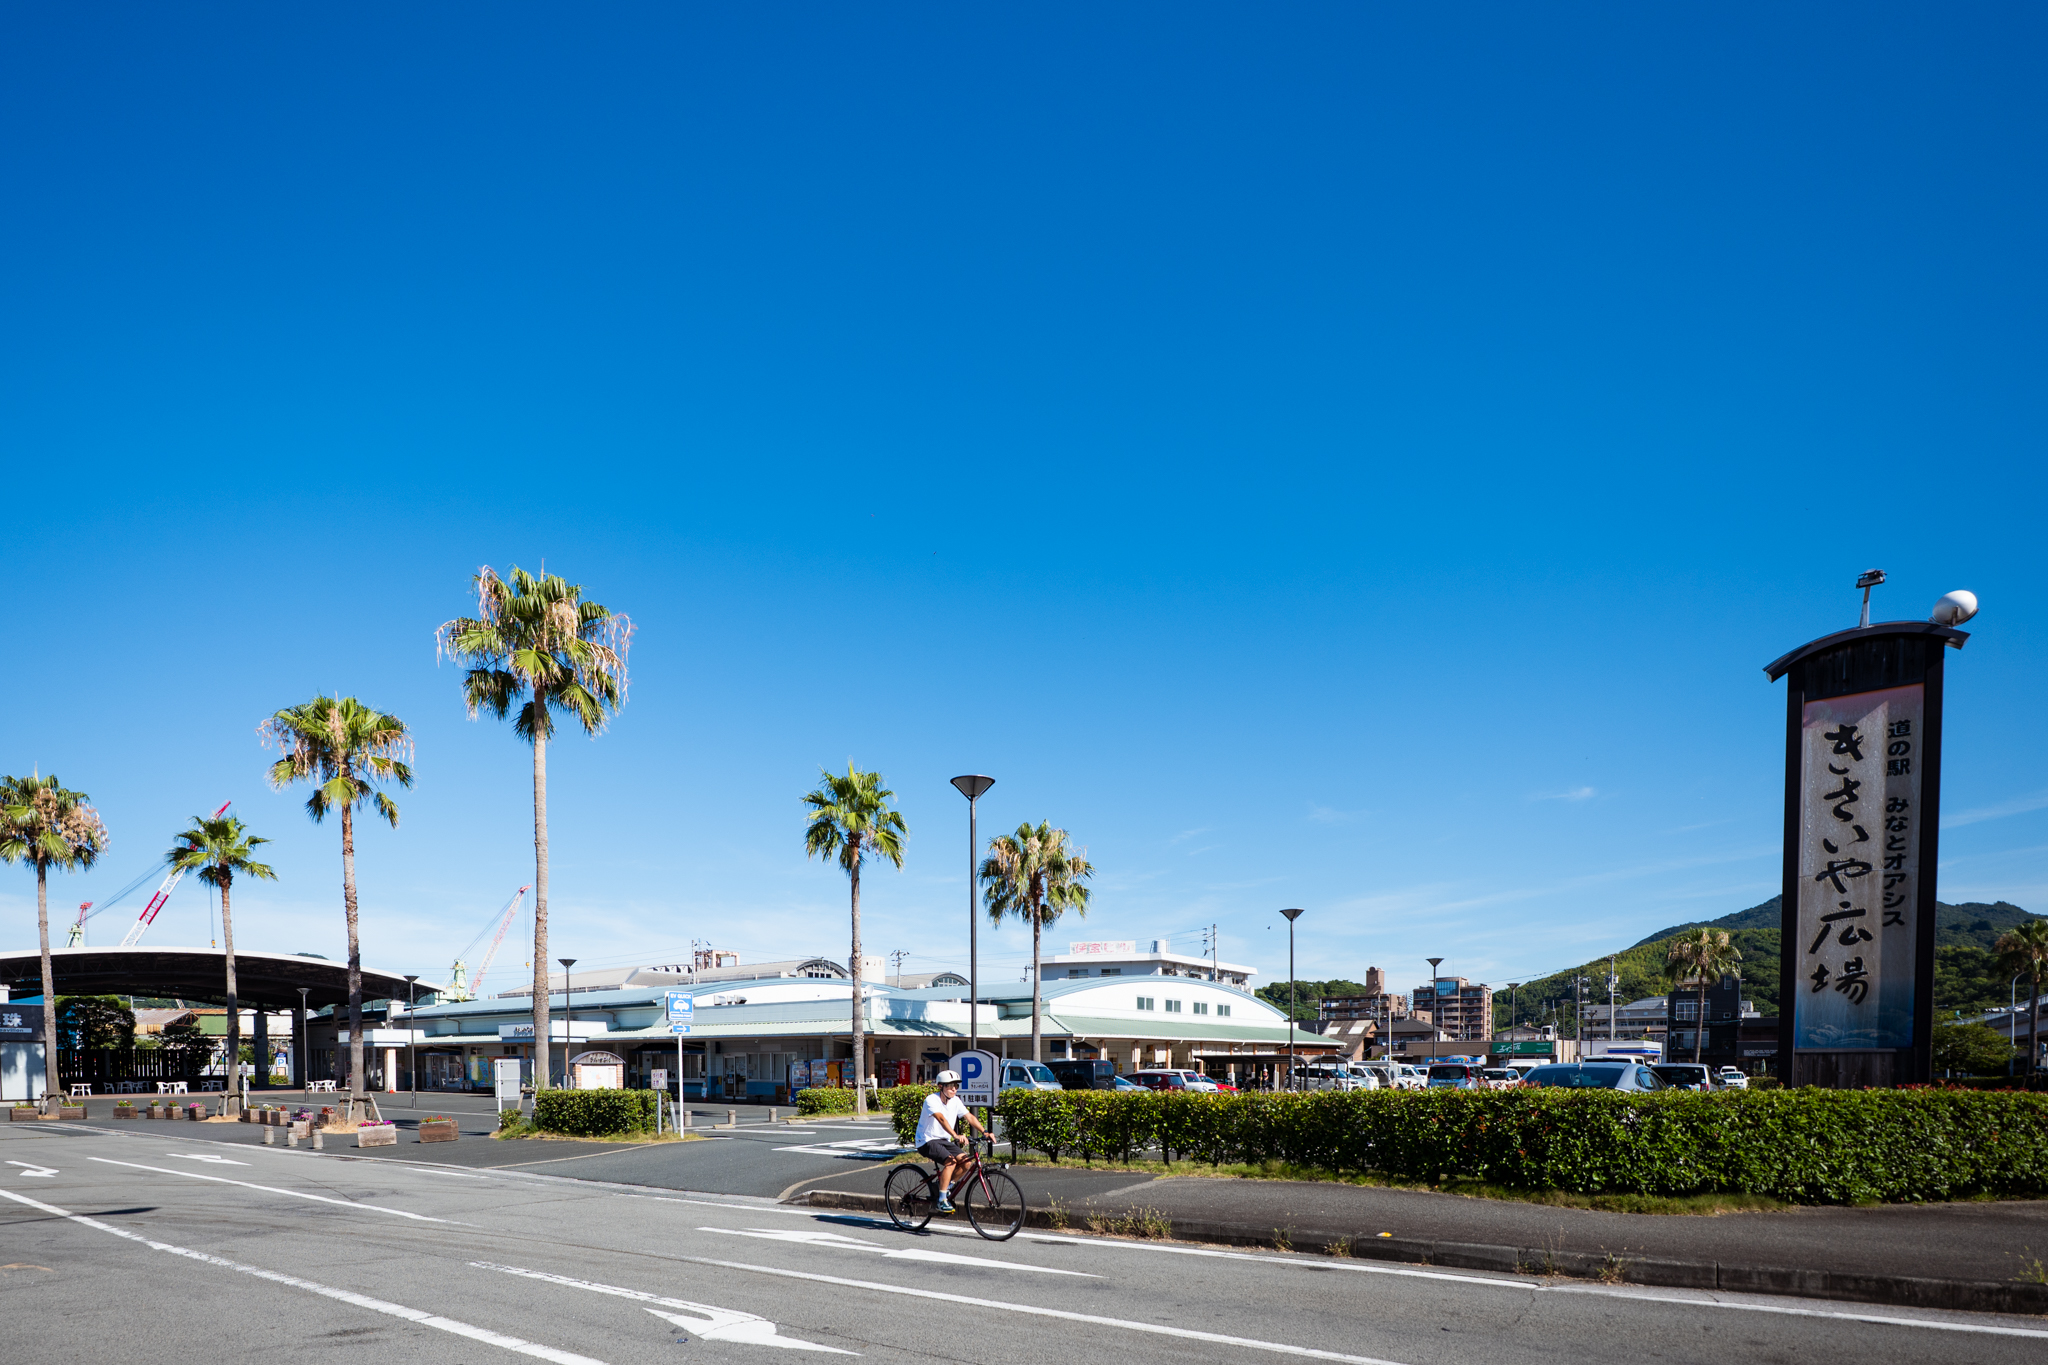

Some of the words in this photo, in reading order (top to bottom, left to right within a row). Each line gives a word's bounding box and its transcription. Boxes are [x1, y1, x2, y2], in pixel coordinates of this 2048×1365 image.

[1886, 719, 1911, 777] 道の駅
[1809, 723, 1874, 1006] きさいや広場
[1882, 797, 1909, 927] みなとオアシス
[0, 1012, 23, 1028] 珠
[961, 1057, 982, 1089] P
